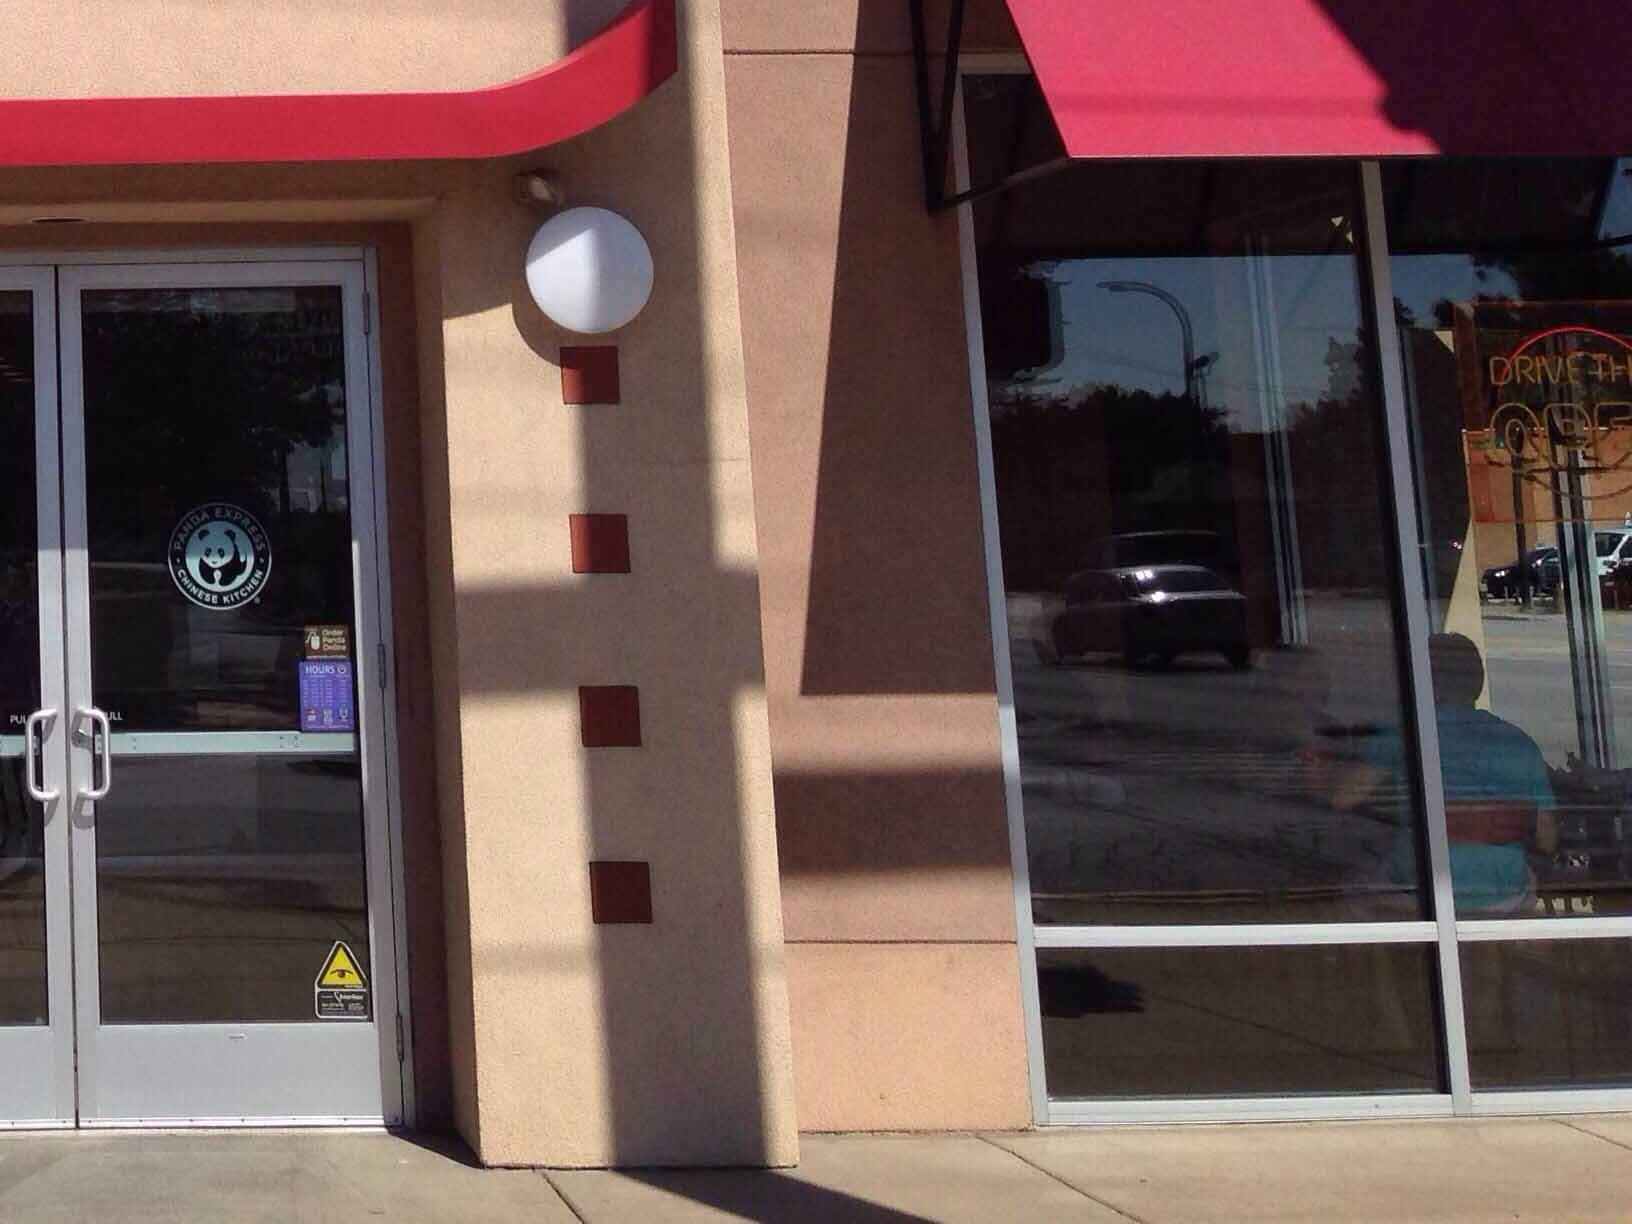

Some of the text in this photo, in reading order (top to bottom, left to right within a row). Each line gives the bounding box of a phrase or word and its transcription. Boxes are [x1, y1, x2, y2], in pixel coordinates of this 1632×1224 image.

[1489, 352, 1578, 385] DRIVE
[174, 507, 266, 551] PANDA EXPRESS
[177, 569, 264, 604] CHINESE KITCHEN
[305, 664, 336, 674] HOURS
